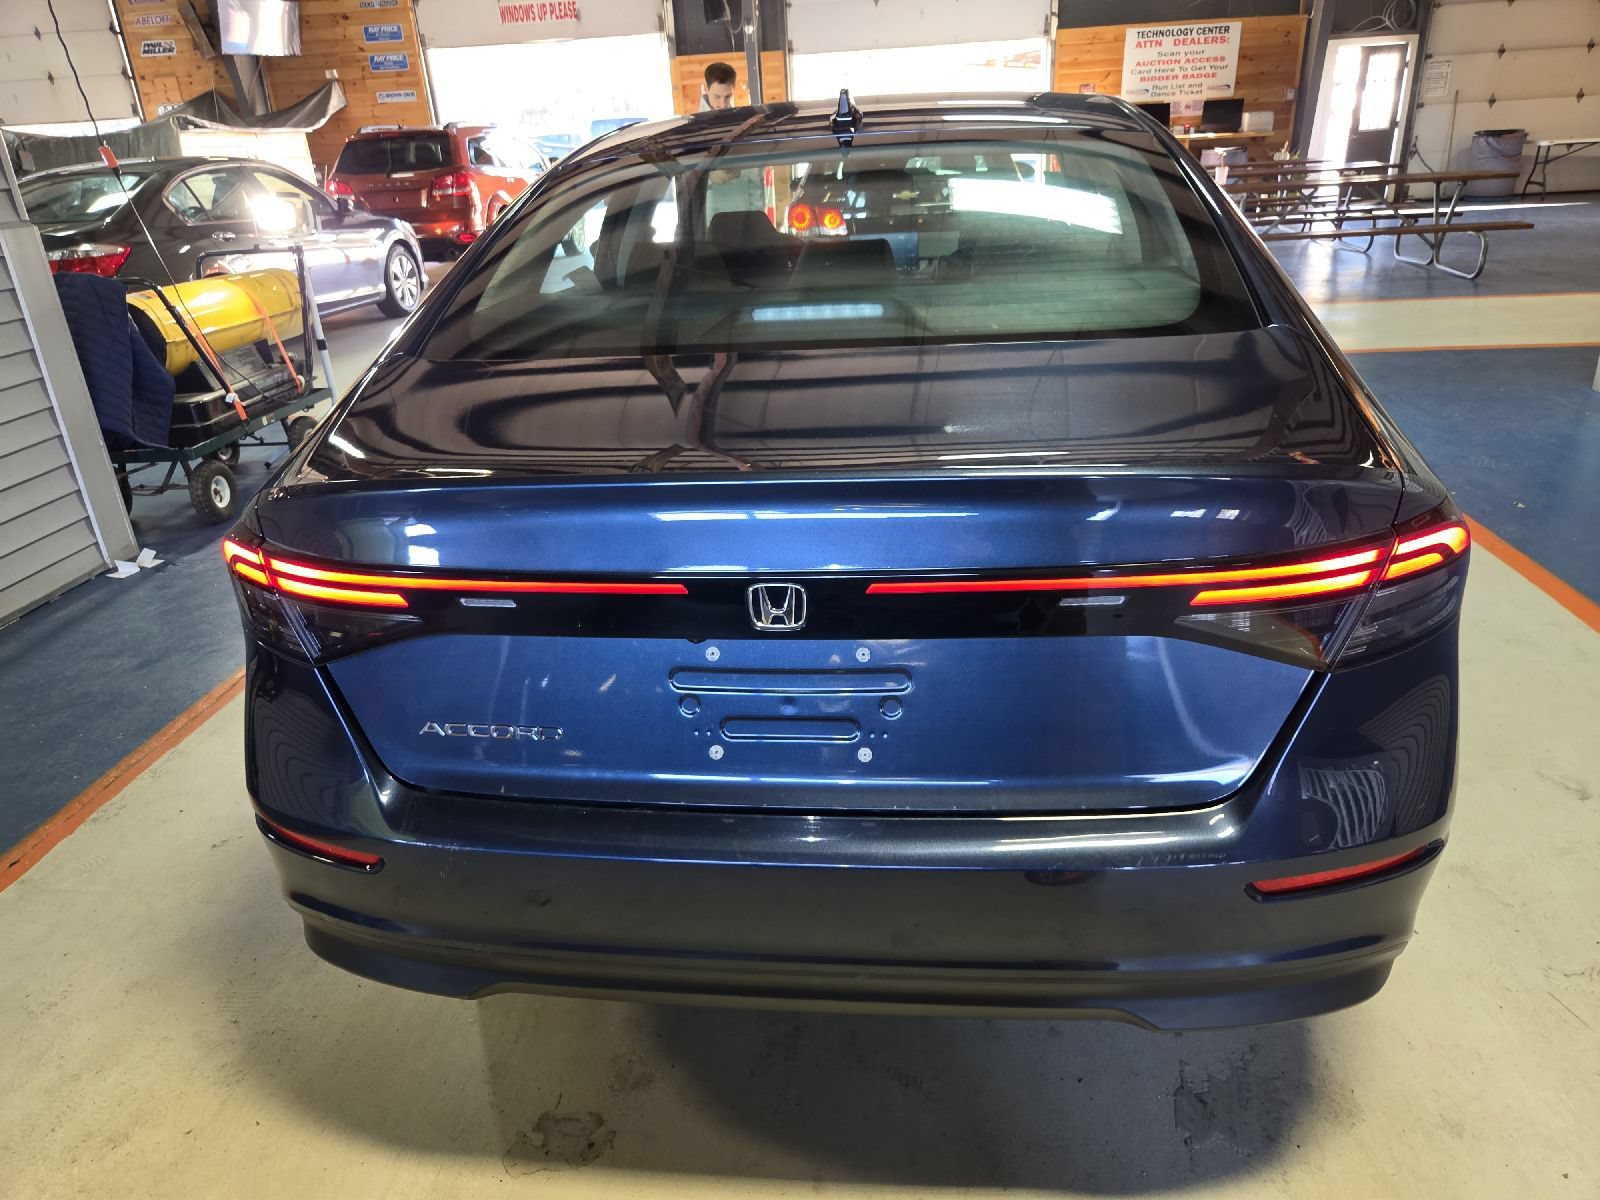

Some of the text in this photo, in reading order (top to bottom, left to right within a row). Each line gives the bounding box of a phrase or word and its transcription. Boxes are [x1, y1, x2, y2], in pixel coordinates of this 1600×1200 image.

[499, 1, 577, 25] WINDOWS UP PLEASE
[135, 15, 171, 26] ABELOFF
[1136, 25, 1230, 39] TECHNOLOGY CENTER
[1135, 36, 1231, 49] ATTN DEALERS:
[142, 46, 175, 55] MILLER
[1157, 48, 1206, 58] Scan your
[1135, 56, 1227, 67] AUCTION ACCESS
[1130, 63, 1229, 76] Card Here To Get Your
[1139, 72, 1218, 83] BIDDER BADGE
[1152, 84, 1169, 92] Run
[1188, 81, 1203, 90] and
[1150, 90, 1177, 98] Dance
[418, 720, 564, 741] ACCORD
